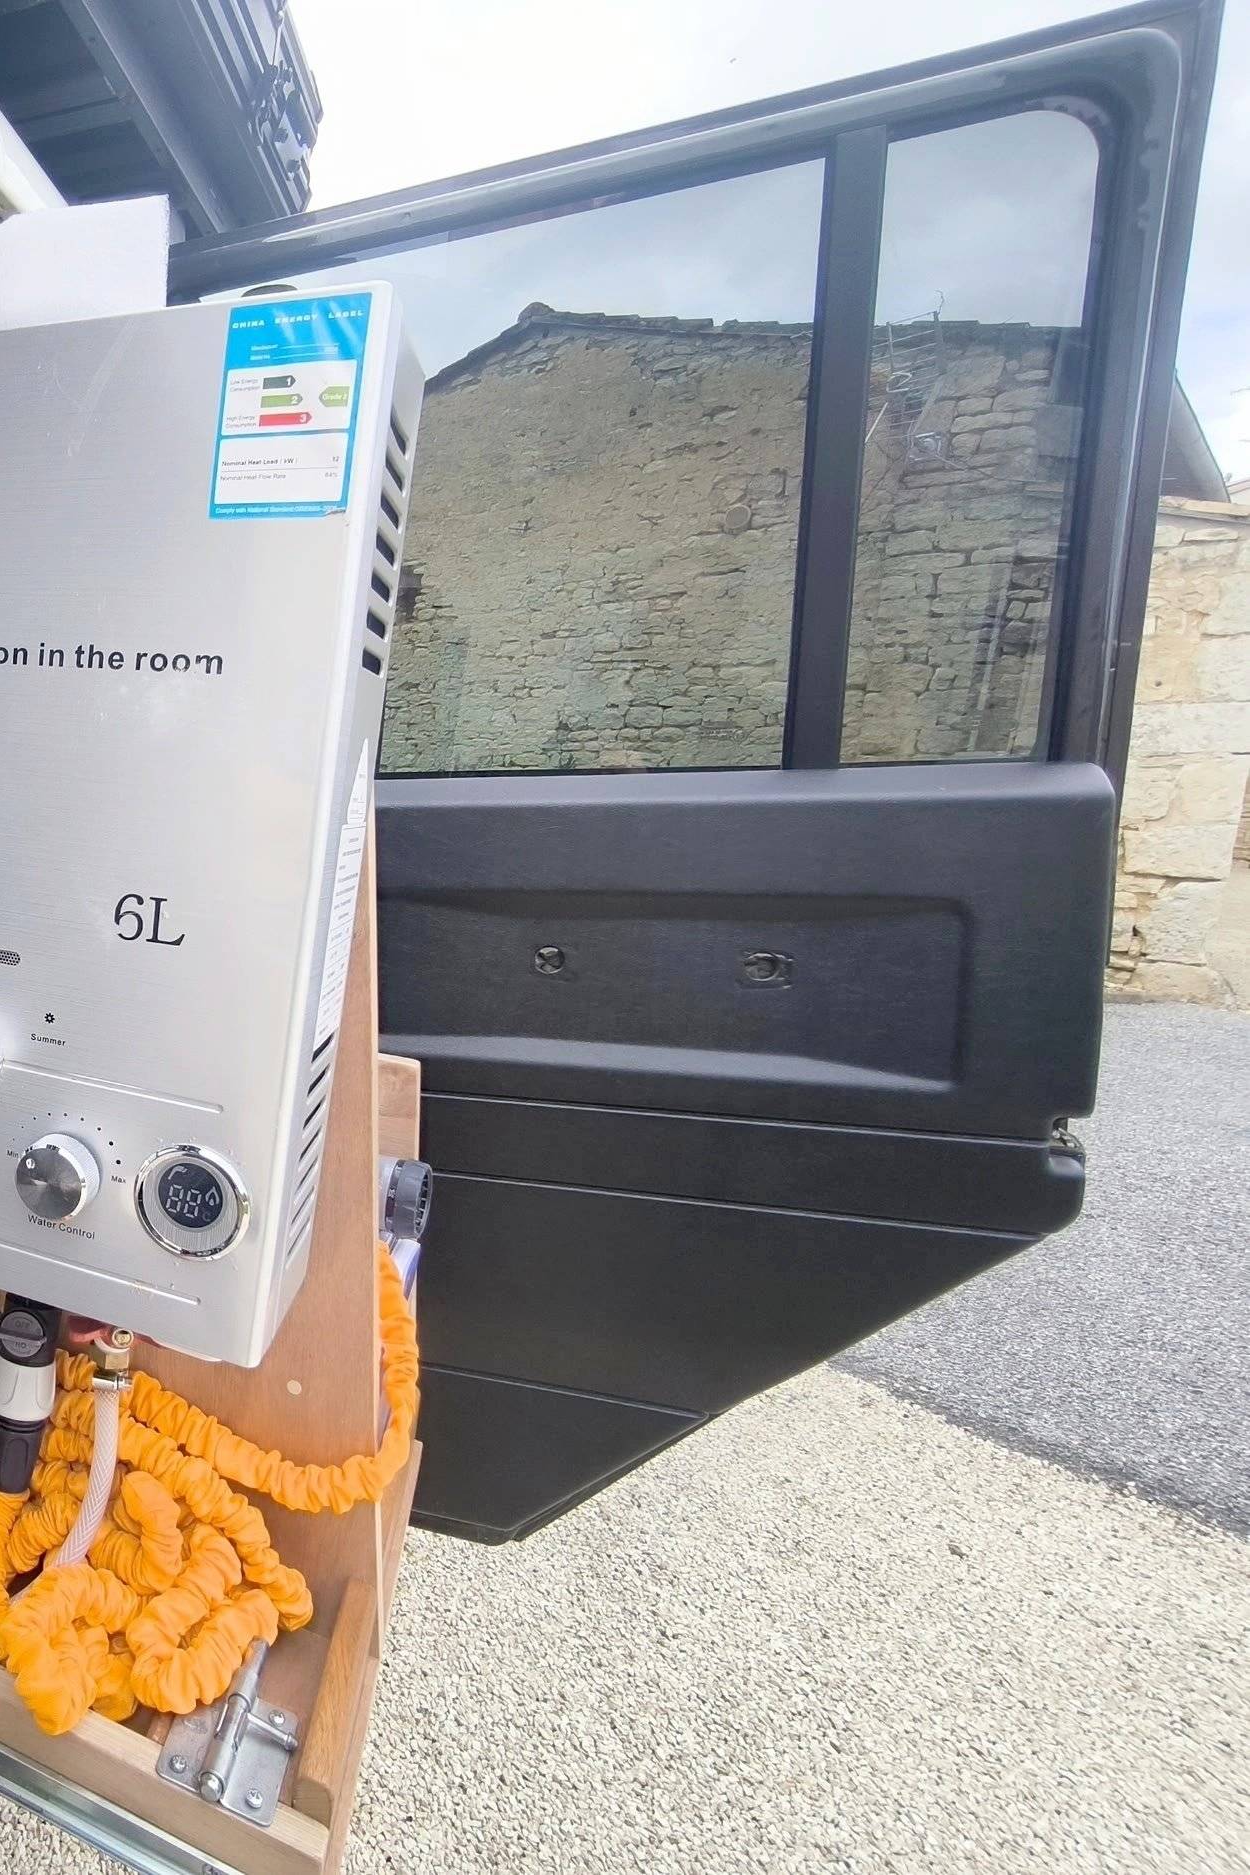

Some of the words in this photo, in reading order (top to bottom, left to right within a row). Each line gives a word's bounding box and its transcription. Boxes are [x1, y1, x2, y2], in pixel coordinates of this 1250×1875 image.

[232, 320, 265, 328] CHINA
[274, 314, 318, 324] ENERGY
[328, 310, 364, 319] LABEL
[286, 377, 292, 385] 1
[291, 396, 298, 404] 2
[299, 414, 307, 422] 3
[38, 642, 65, 668] in
[74, 644, 125, 670] the
[135, 652, 223, 675] room
[114, 893, 186, 946] 6L
[30, 1033, 67, 1048] Summer
[6, 1150, 20, 1159] Min
[111, 1175, 127, 1184] Max
[28, 1214, 57, 1230] Water
[59, 1222, 96, 1240] Control
